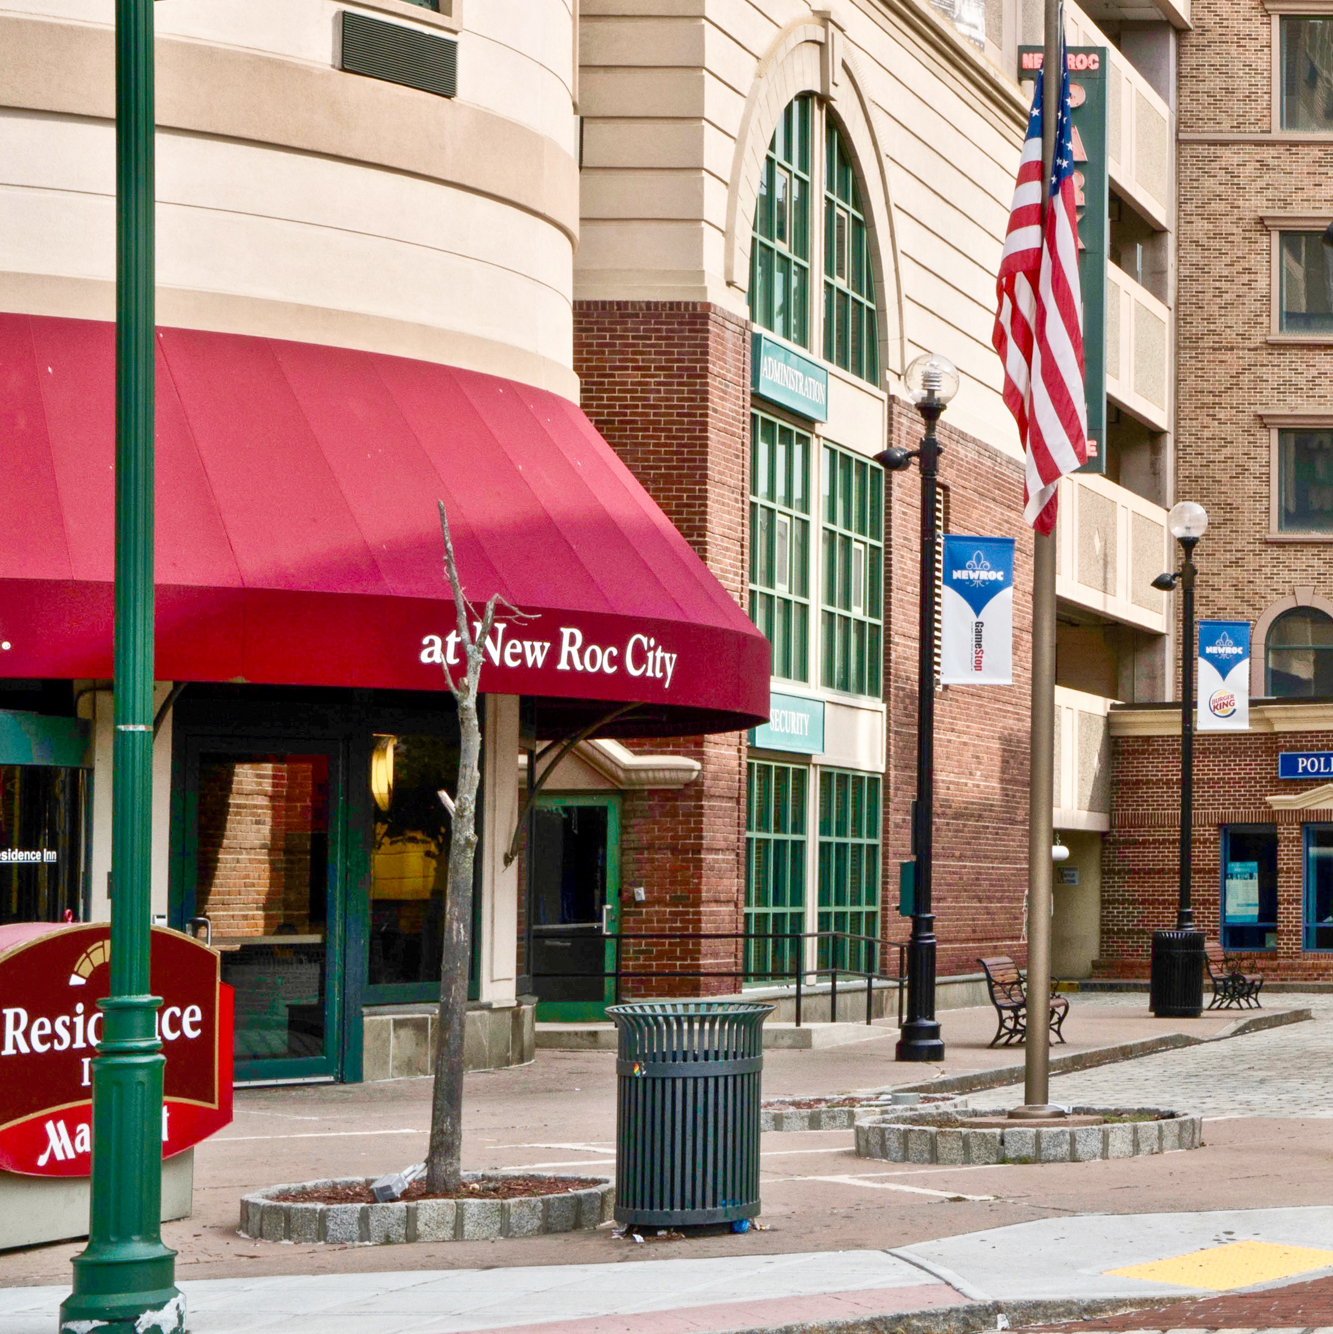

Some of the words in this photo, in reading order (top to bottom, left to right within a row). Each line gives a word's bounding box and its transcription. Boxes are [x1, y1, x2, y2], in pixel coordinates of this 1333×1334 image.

[762, 355, 826, 406] ADMINISTRATION
[952, 569, 1004, 581] NEWROC
[974, 621, 985, 672] GameStop
[1205, 646, 1243, 654] NEWROC
[420, 630, 461, 665] at
[472, 622, 550, 668] New
[557, 627, 618, 674] Roc
[625, 633, 677, 689] City
[1211, 694, 1235, 705] BURGER
[1212, 699, 1236, 713] KING
[770, 708, 810, 736] SECURITY
[0, 848, 41, 862] sidence
[43, 848, 57, 862] Inn
